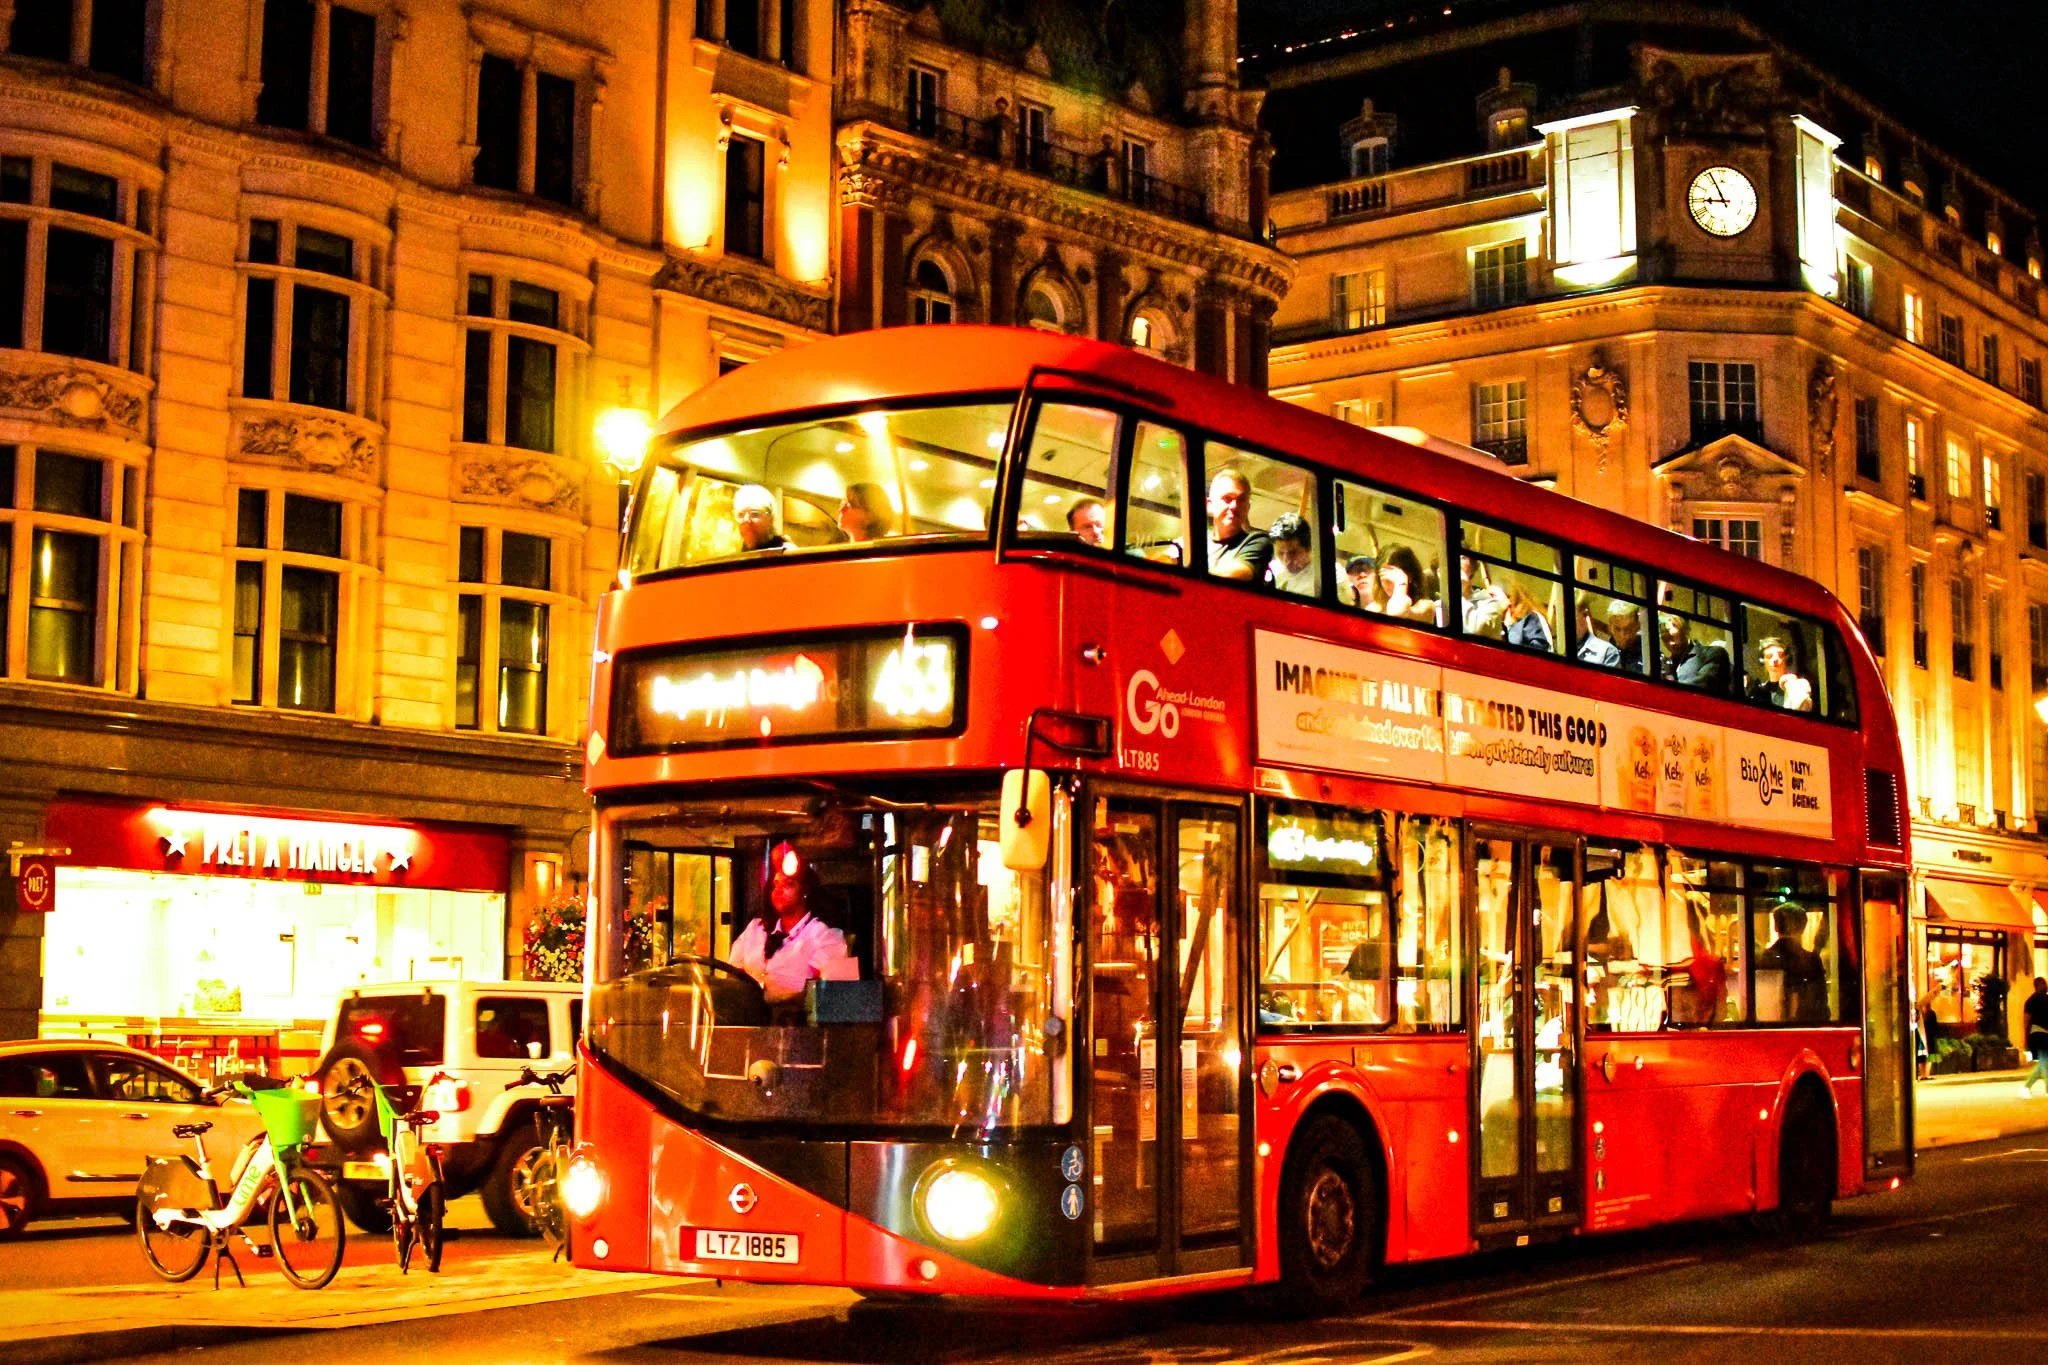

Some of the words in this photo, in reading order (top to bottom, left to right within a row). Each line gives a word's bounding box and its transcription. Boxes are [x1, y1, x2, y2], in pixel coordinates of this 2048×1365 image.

[1126, 669, 1179, 738] Go
[1361, 677, 1378, 707] IF
[1381, 680, 1412, 714] ALL
[1528, 709, 1563, 741] THIS
[1565, 715, 1607, 748] GOOD
[1124, 749, 1160, 771] LT885
[1552, 750, 1595, 777] cultures
[202, 825, 256, 867] PRET
[263, 831, 282, 868] A
[289, 832, 377, 874] MANGER
[706, 1232, 740, 1255] LTZ
[746, 1236, 786, 1258] 1885
